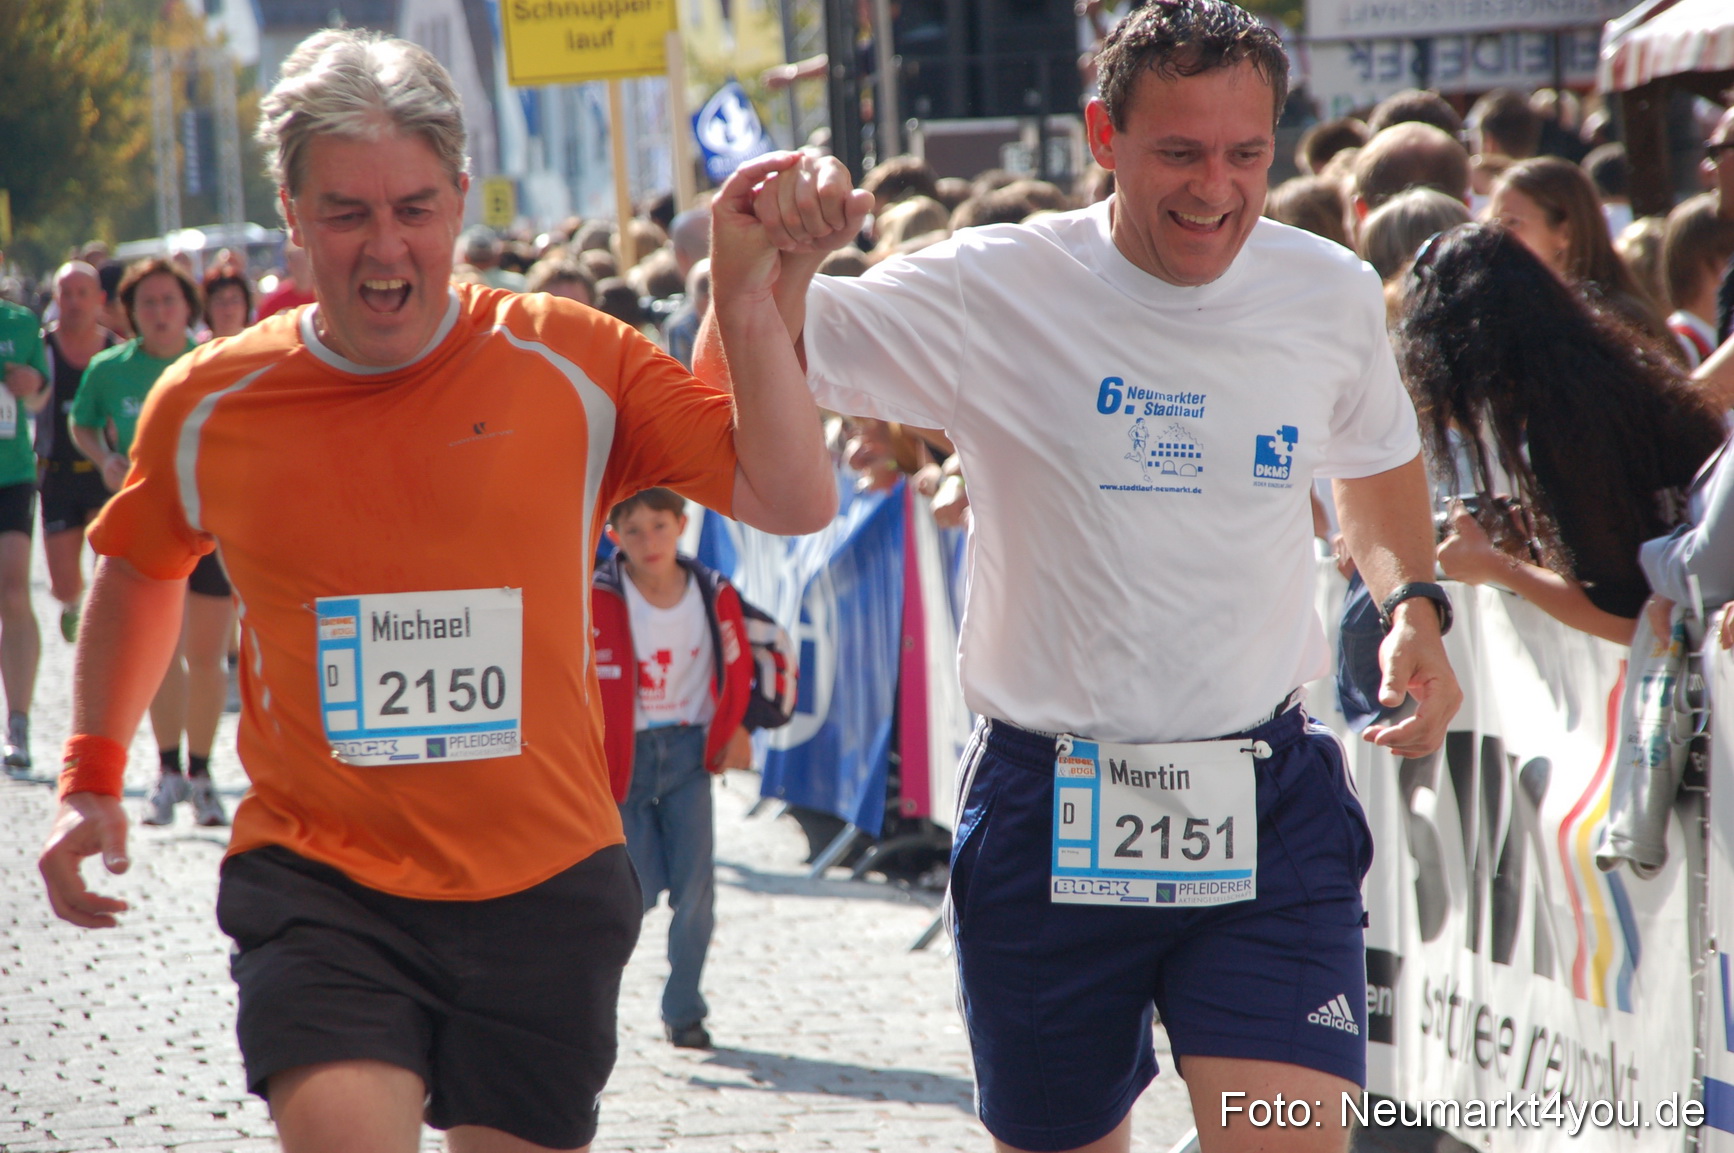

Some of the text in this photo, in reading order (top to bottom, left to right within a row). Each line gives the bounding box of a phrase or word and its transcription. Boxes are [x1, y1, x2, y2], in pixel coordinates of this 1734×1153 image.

[567, 28, 615, 49] lauf
[1097, 376, 1206, 415] 6. Neumarkter
[1144, 401, 1205, 418] Stadtlauf
[1255, 464, 1289, 480] DKMS
[1099, 483, 1202, 494] www.stadtlauf-neumarkt.de
[372, 607, 471, 642] Michael
[327, 664, 339, 687] D
[379, 665, 506, 716] 2150
[450, 731, 518, 749] PFLEIDERER
[1109, 758, 1190, 790] Martin
[1063, 802, 1075, 824] D
[1114, 814, 1234, 861] 2151
[1054, 879, 1252, 895] BOCK PFLEIDERER
[1307, 1013, 1359, 1036] adidas
